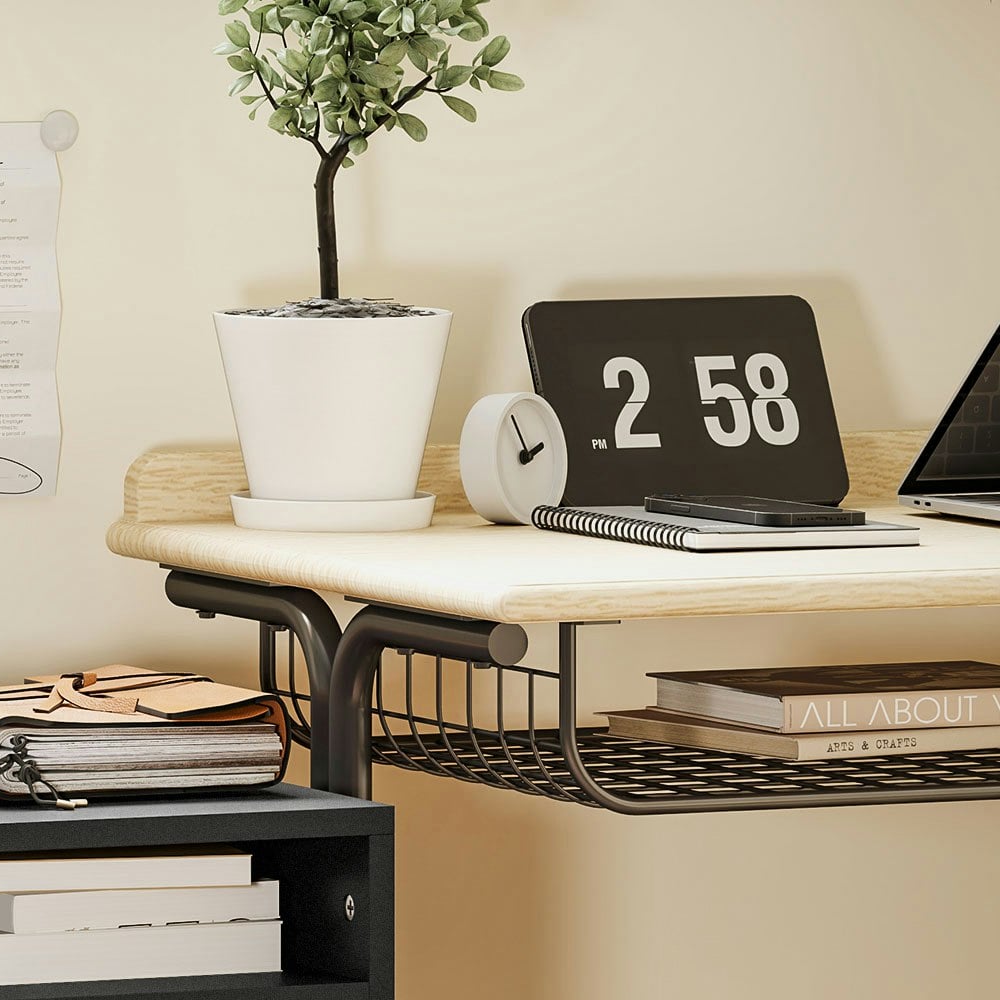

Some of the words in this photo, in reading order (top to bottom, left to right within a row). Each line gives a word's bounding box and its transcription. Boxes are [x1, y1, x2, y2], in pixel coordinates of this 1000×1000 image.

[603, 356, 662, 449] 2
[694, 353, 800, 448] 58
[592, 439, 608, 450] PM
[800, 701, 857, 729] ALL
[868, 696, 977, 726] ABOUT
[827, 742, 855, 753] ARTS
[862, 740, 869, 750] &
[876, 738, 917, 749] CRAFTS
